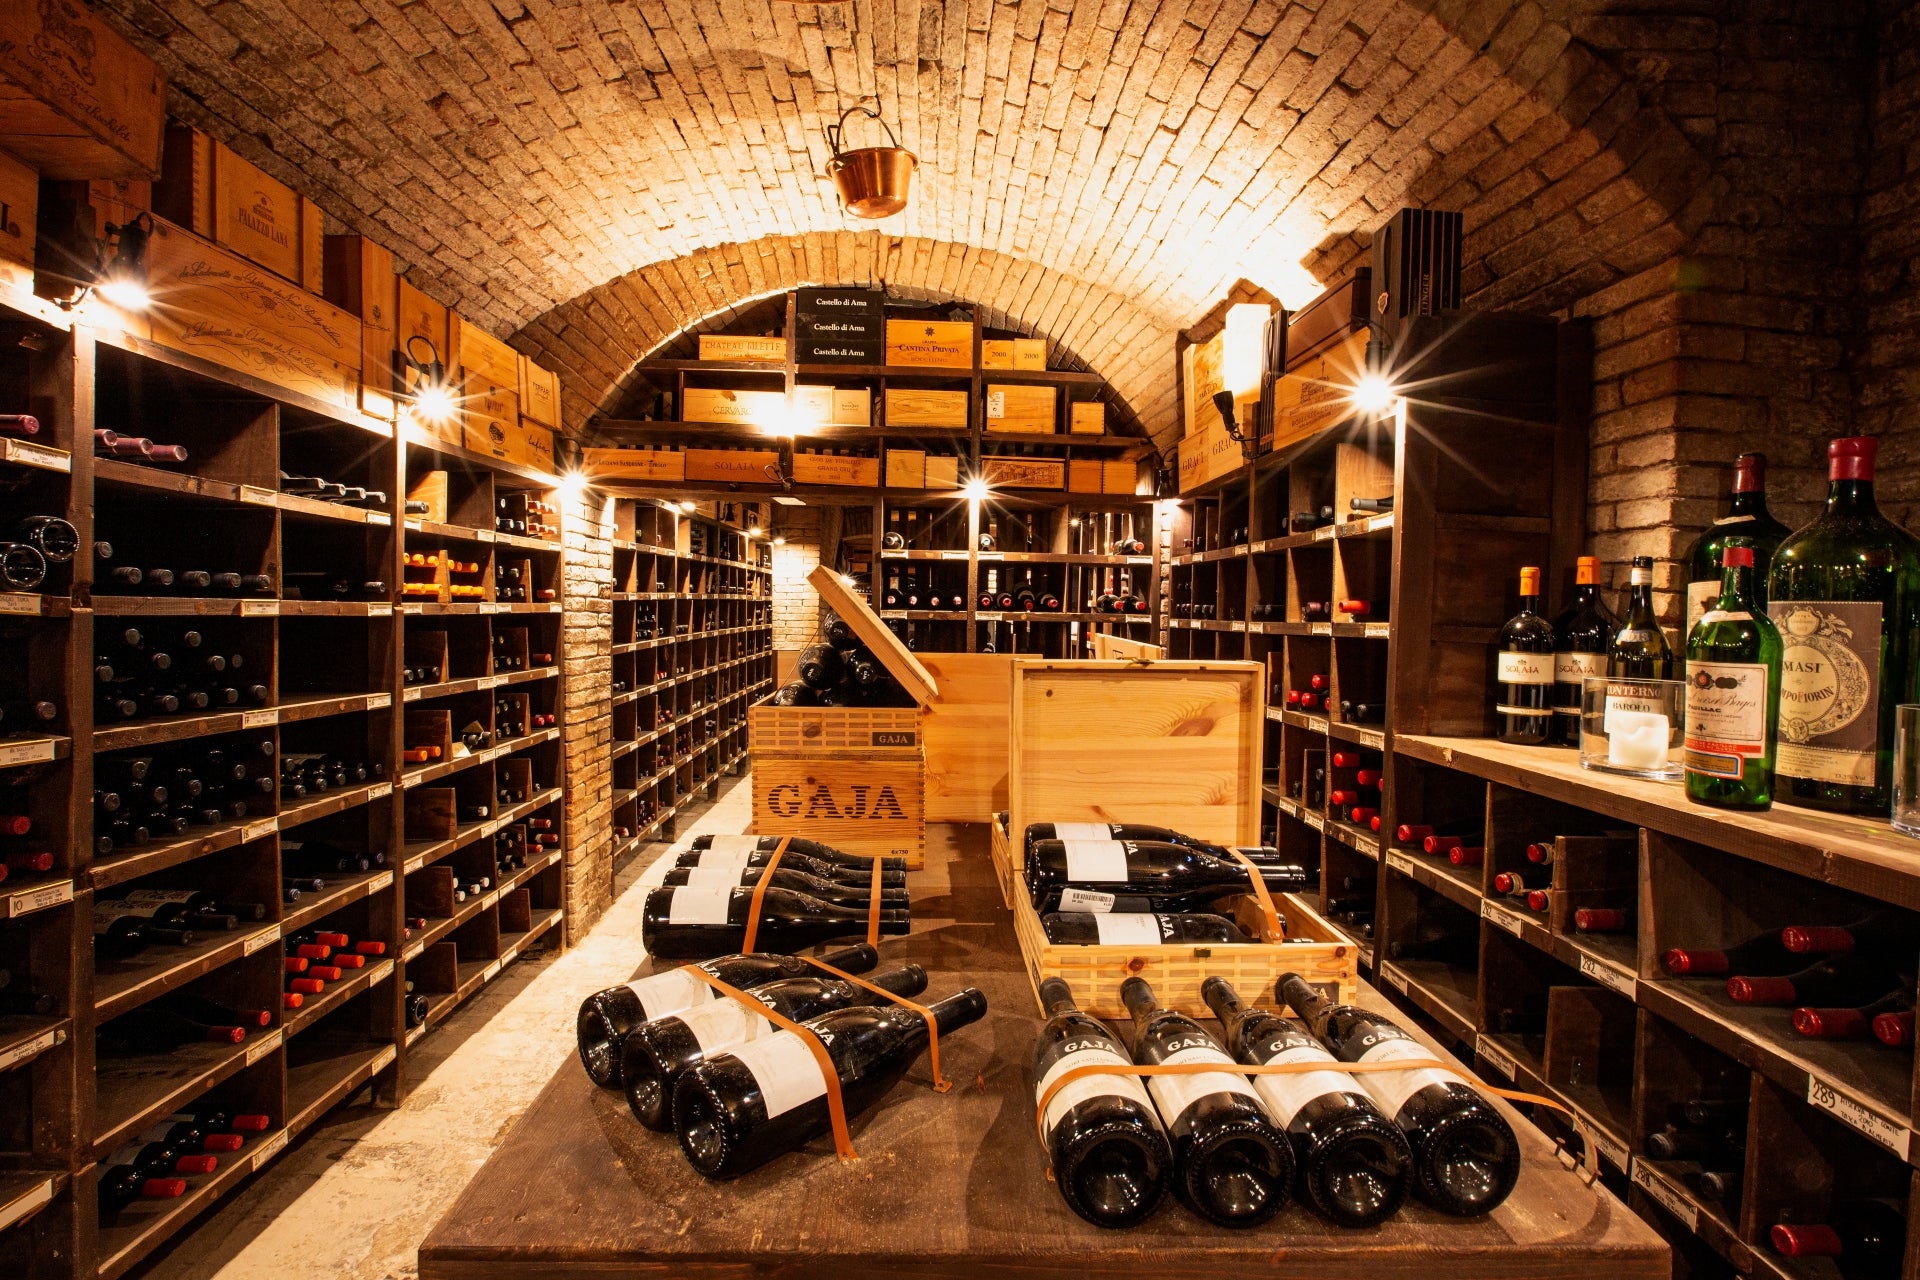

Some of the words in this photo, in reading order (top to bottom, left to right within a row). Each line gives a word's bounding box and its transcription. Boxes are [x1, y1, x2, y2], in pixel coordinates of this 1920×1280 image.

[238, 207, 270, 238] PALAZZO
[271, 226, 289, 249] LANA
[816, 298, 842, 306] Castello
[843, 298, 850, 306] di
[813, 323, 840, 331] Castello
[848, 324, 865, 332] Ama
[813, 347, 840, 356] Castello
[840, 348, 847, 356] di
[848, 349, 865, 357] Ama
[899, 343, 930, 352] CANTINA
[932, 345, 960, 353] PRIVATA
[714, 462, 755, 471] SOLAIA
[817, 465, 839, 473] GRAND
[1504, 664, 1539, 675] SOLAIA
[1558, 664, 1595, 674] SOLAIA
[1782, 661, 1821, 674] MASI
[1781, 686, 1834, 703] MPOFIORIN
[1612, 702, 1651, 713] BAROLO
[879, 735, 908, 744] GAJA
[767, 784, 908, 819] GAJA
[1158, 913, 1175, 939] AJA
[1582, 954, 1596, 975] 282
[745, 987, 777, 1010] AJA
[799, 1019, 836, 1047] AJA
[1362, 1029, 1415, 1046] GAJA
[1064, 1039, 1119, 1055] GAJA
[1167, 1037, 1223, 1053] GAJA
[1269, 1037, 1323, 1052] GAJA
[1812, 1080, 1836, 1109] 289
[1840, 1097, 1865, 1116] RISERVA
[1880, 1120, 1900, 1137] CONTE
[1635, 1163, 1652, 1188] 288
